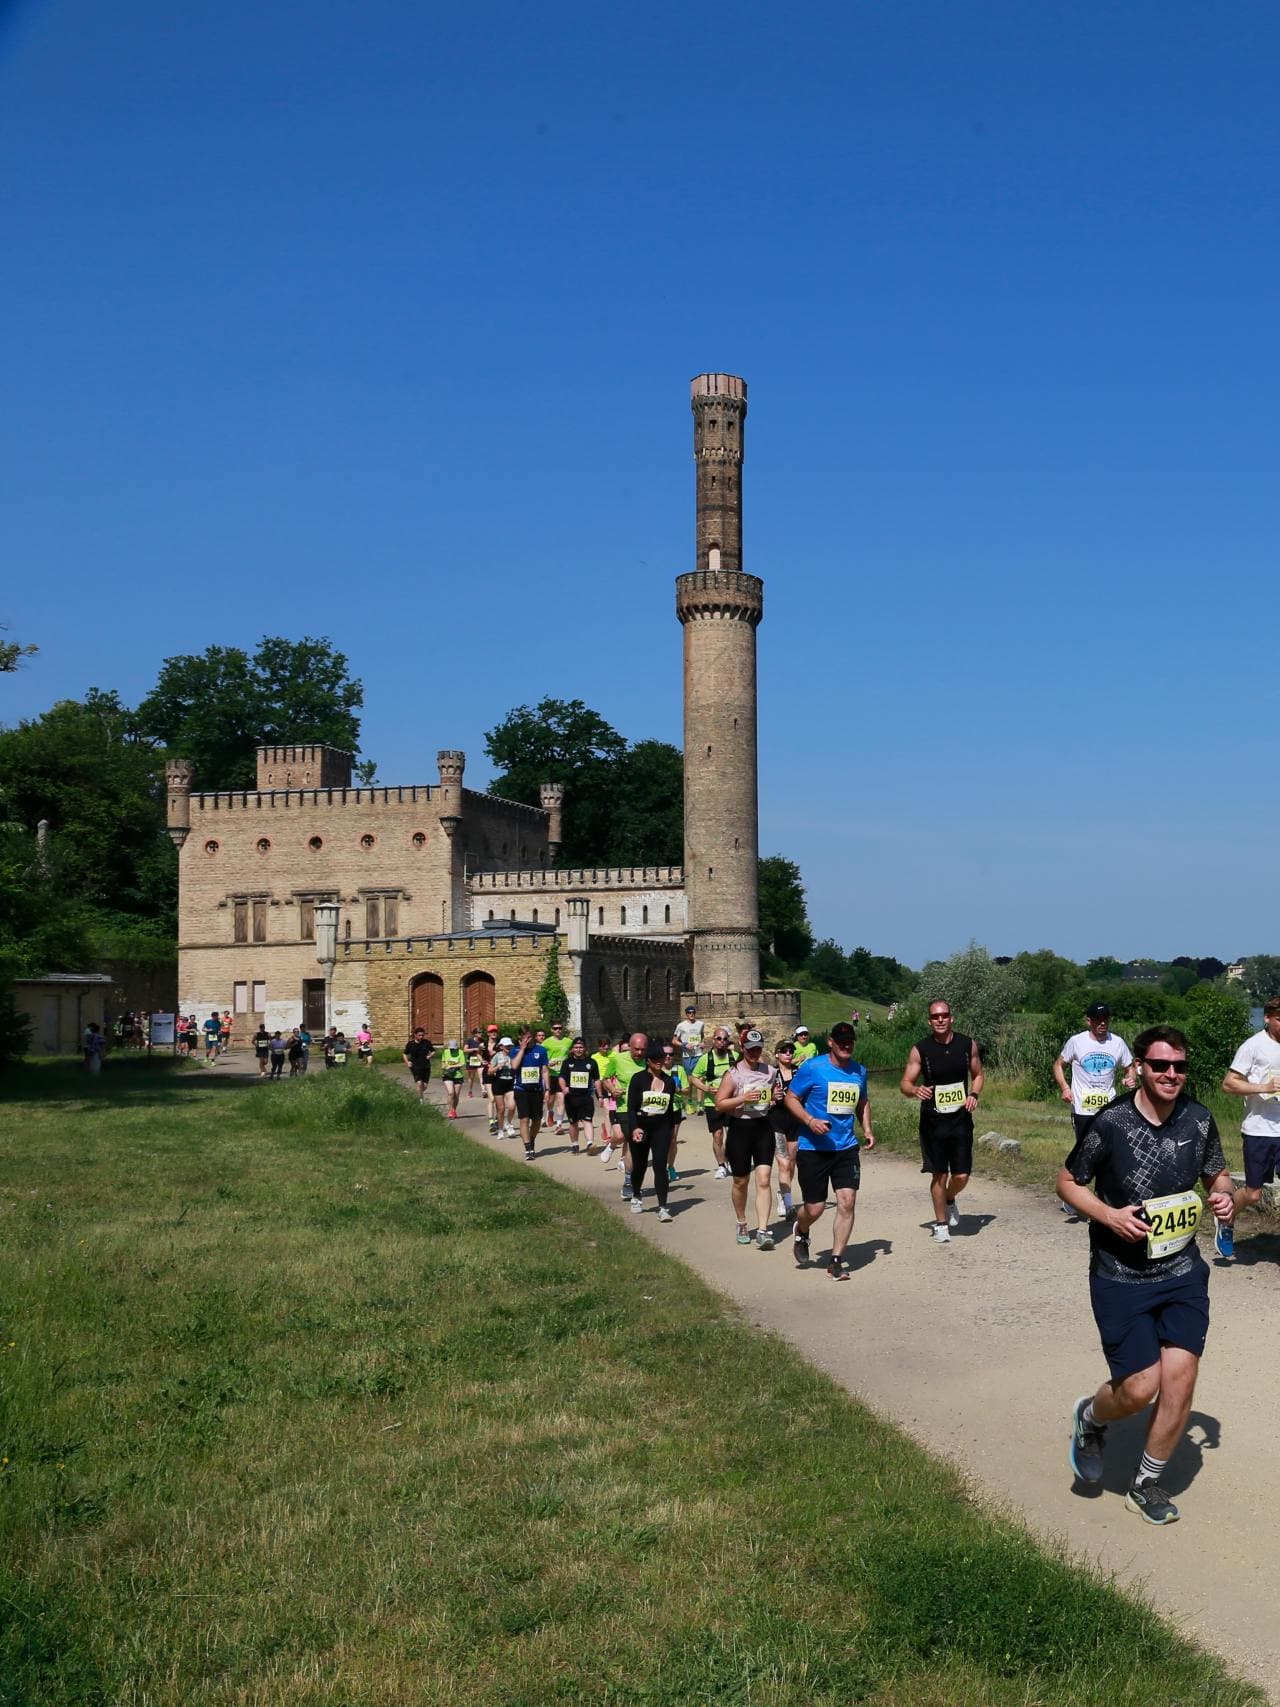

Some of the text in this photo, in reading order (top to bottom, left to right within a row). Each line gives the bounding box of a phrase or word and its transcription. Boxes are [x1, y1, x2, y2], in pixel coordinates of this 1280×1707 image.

[831, 1090, 856, 1103] 2994
[938, 1090, 963, 1104] 2520
[1151, 1205, 1197, 1237] 2445
